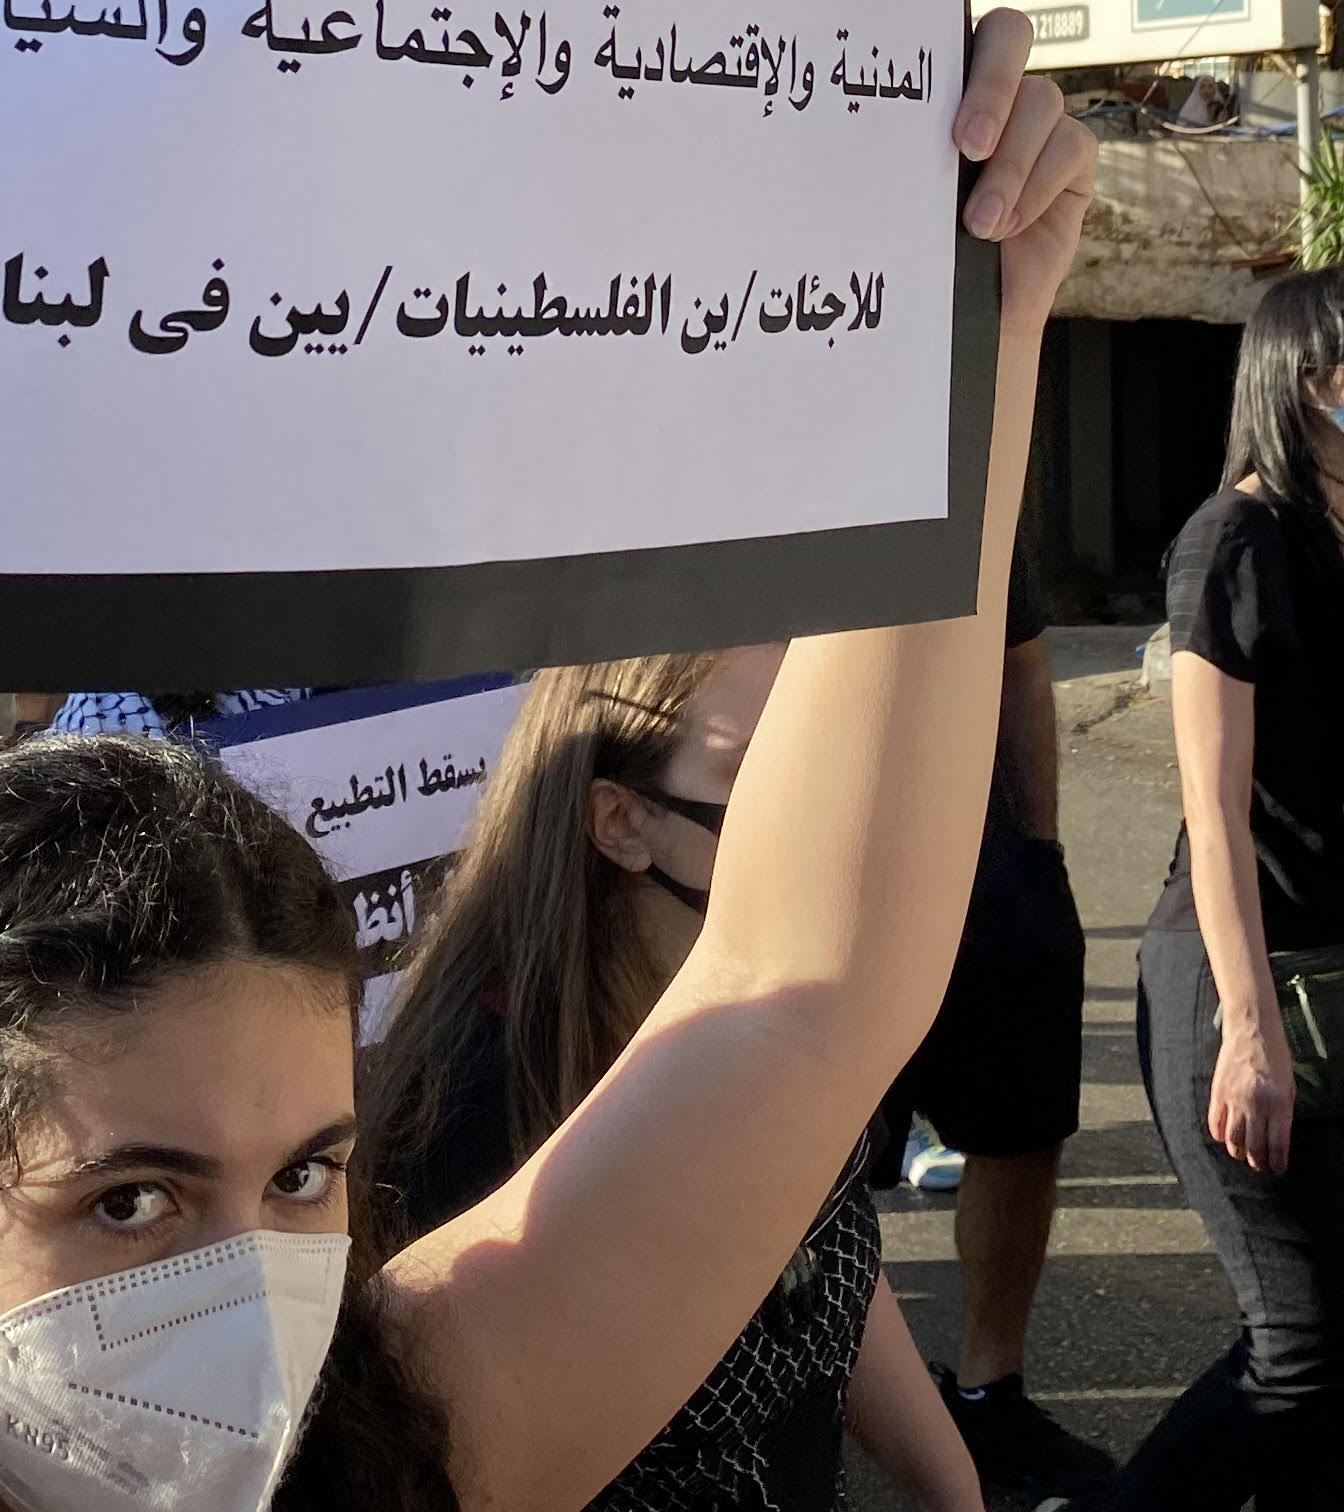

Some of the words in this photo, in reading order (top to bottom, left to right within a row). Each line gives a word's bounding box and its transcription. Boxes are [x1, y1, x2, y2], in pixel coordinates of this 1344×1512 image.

[593, 4, 815, 118] والإقتصادية
[830, 29, 932, 114] المدنية
[305, 763, 407, 839] التطبيع
[7, 1414, 69, 1461] KN95
